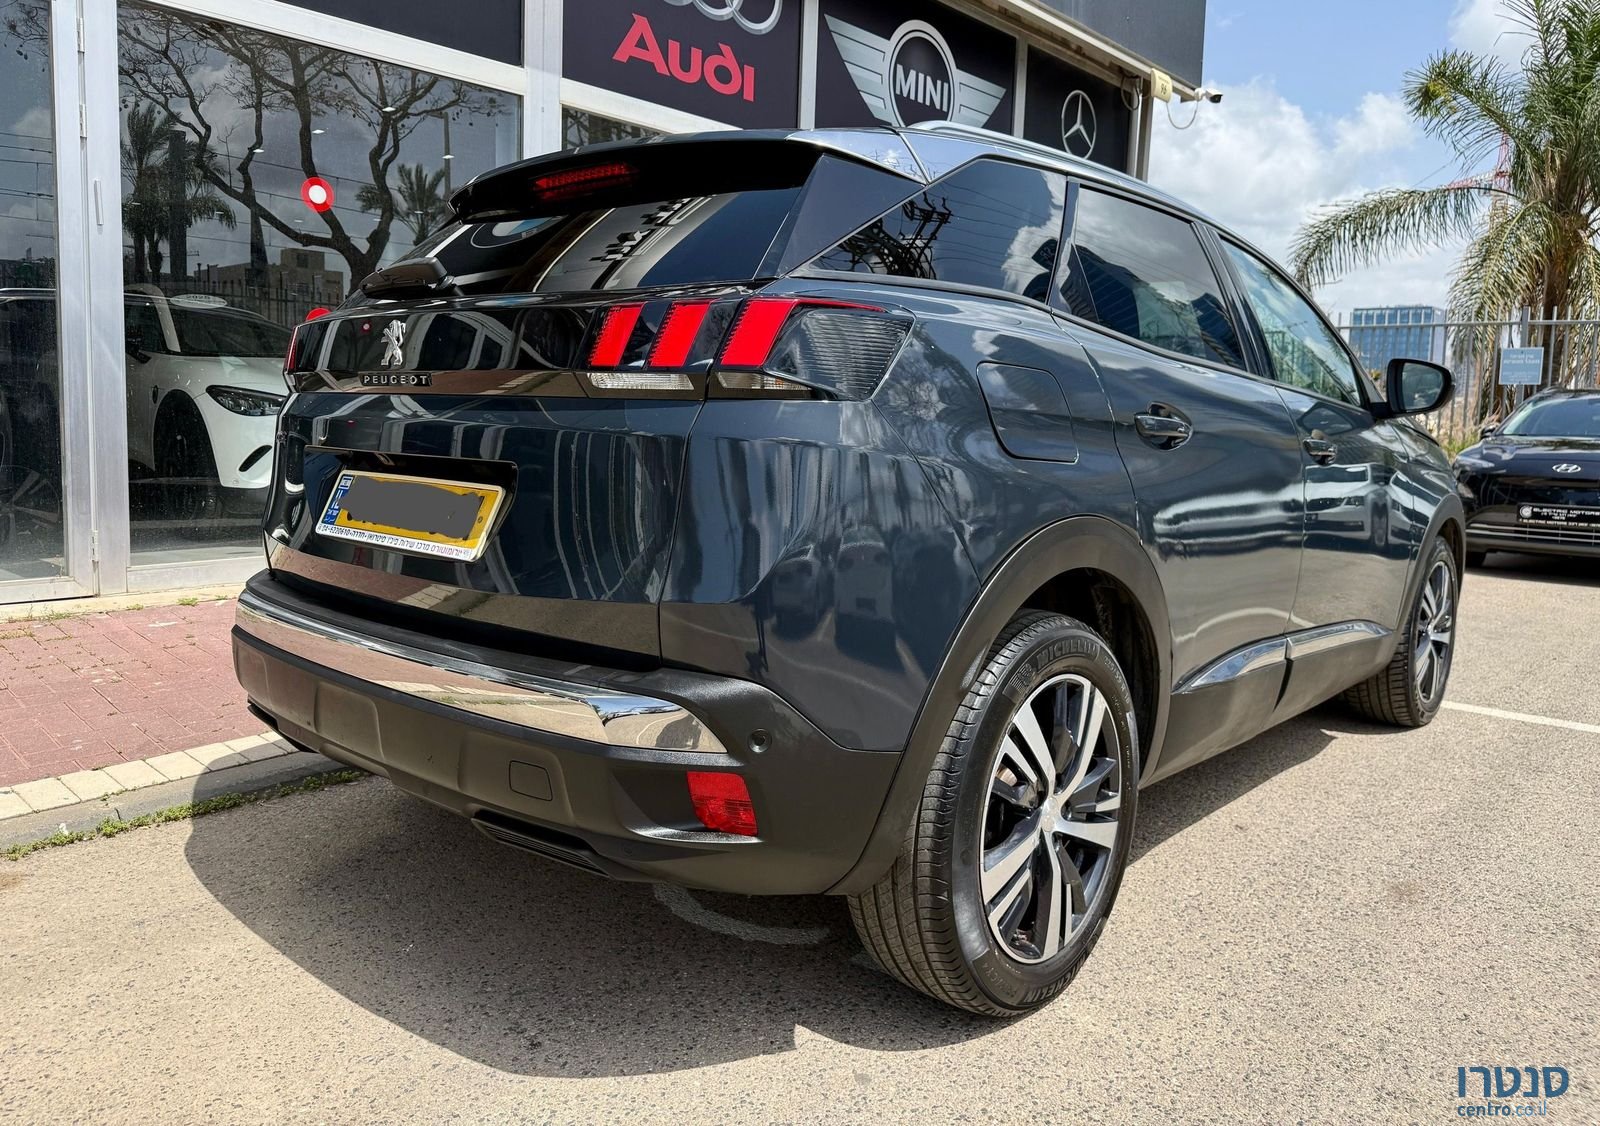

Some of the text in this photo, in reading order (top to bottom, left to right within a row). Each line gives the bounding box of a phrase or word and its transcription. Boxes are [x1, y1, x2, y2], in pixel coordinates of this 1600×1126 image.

[612, 12, 755, 102] Audi
[896, 63, 949, 113] MINI
[363, 375, 429, 385] PEUGEOT
[1036, 638, 1098, 670] MICHELIN
